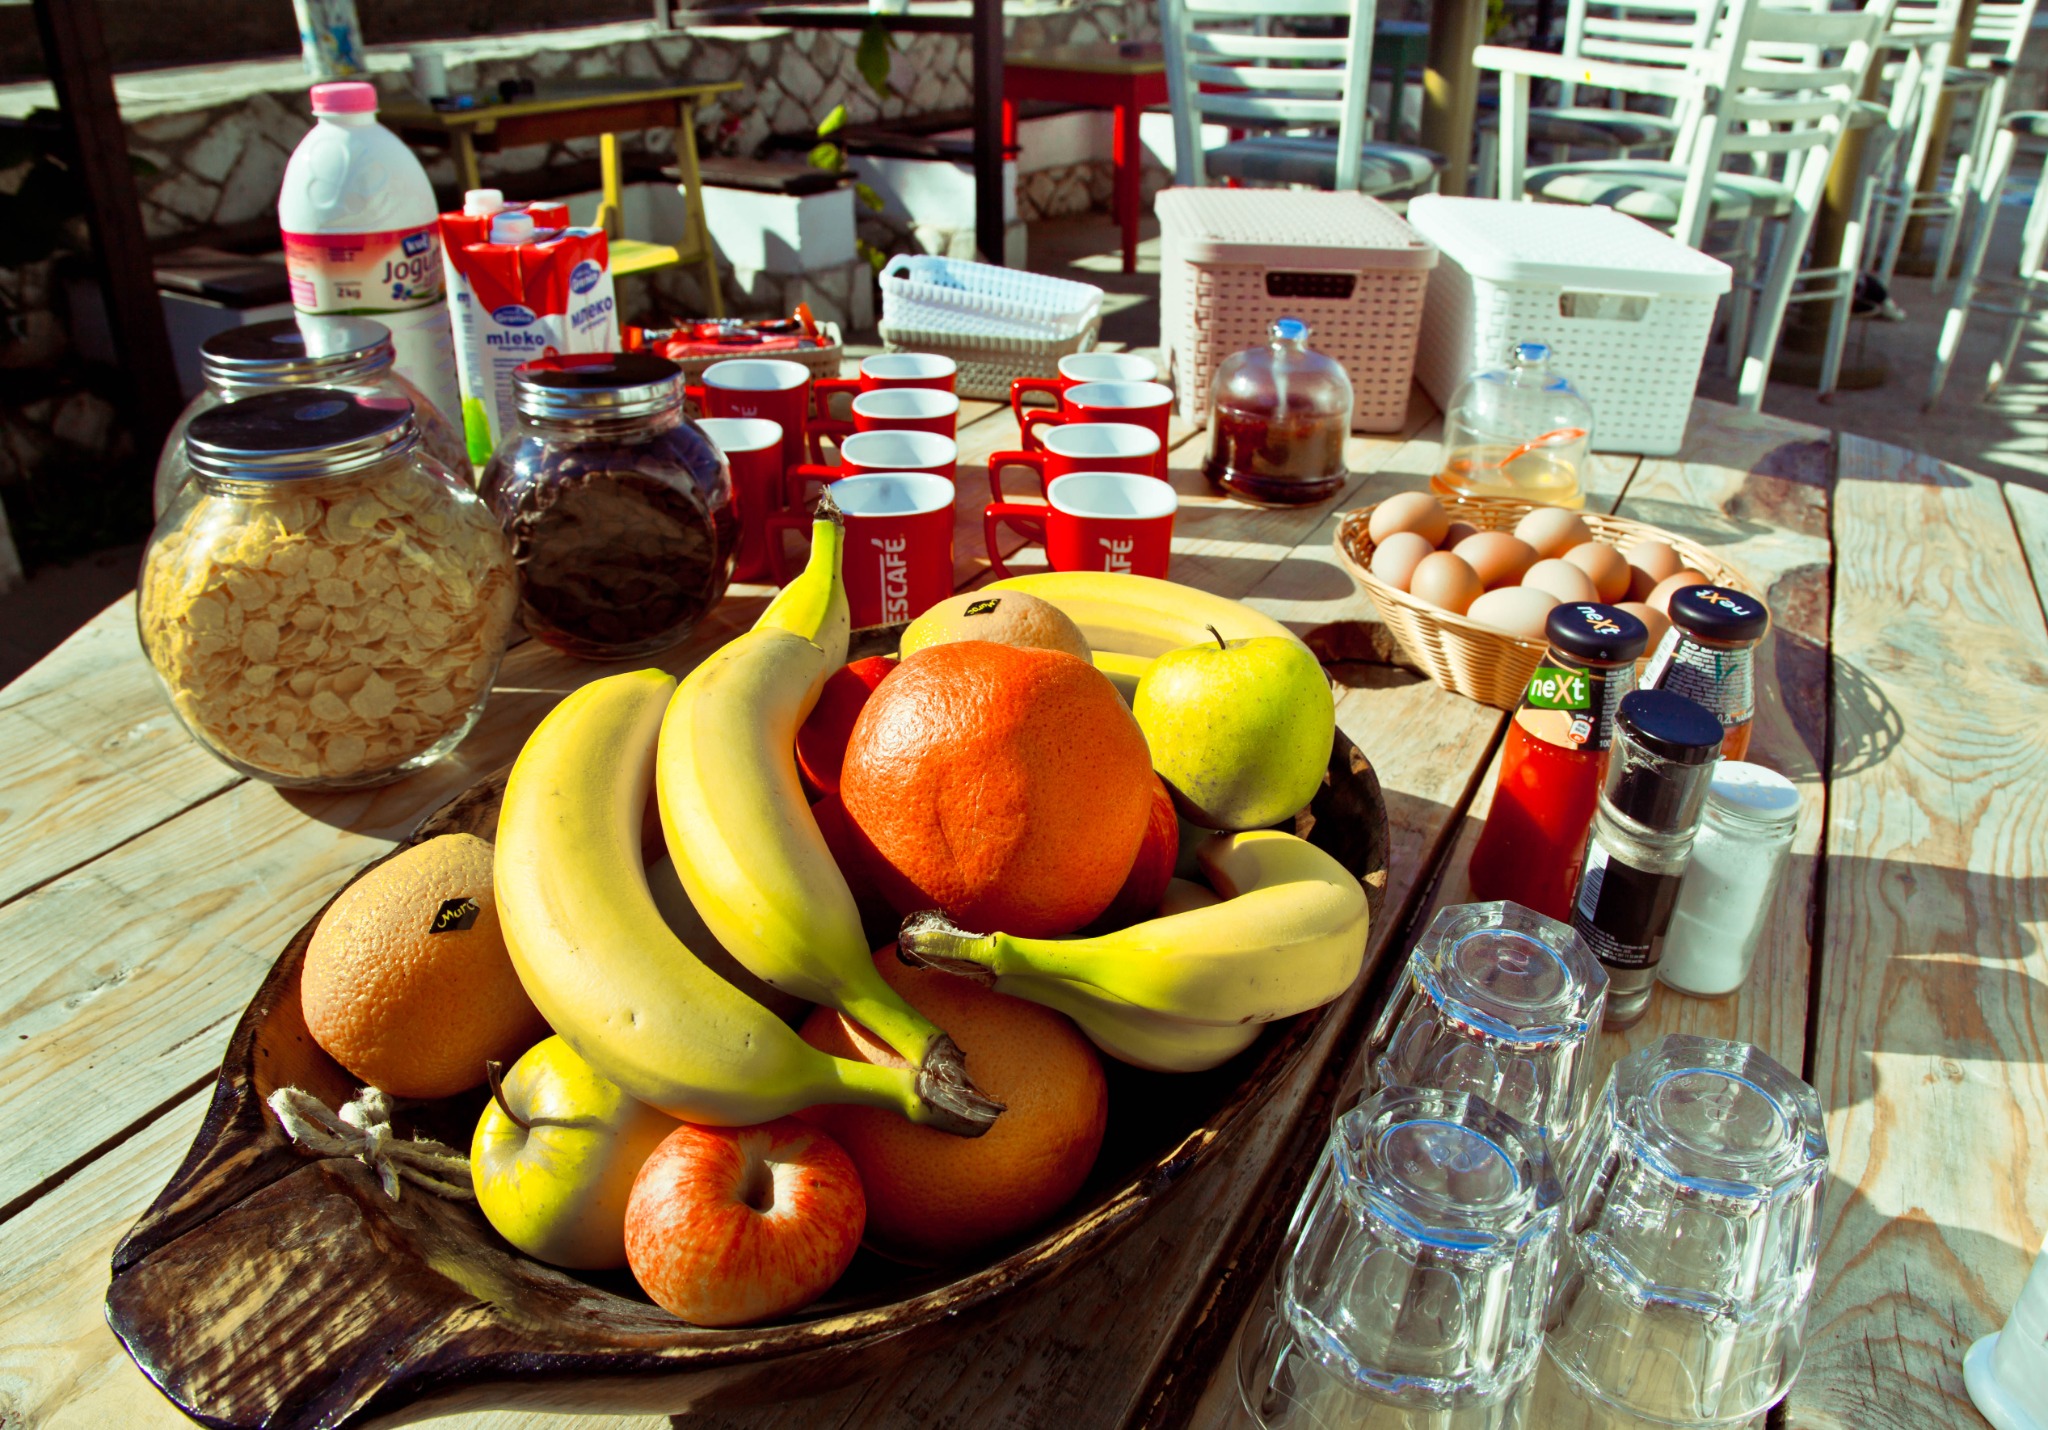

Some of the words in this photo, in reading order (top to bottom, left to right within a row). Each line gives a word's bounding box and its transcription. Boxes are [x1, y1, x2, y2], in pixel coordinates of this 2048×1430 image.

[486, 331, 545, 345] mleko
[871, 537, 909, 626] ESCAFÉ
[1696, 589, 1750, 616] neXt
[1576, 606, 1621, 635] neXt
[1530, 674, 1585, 705] neXt
